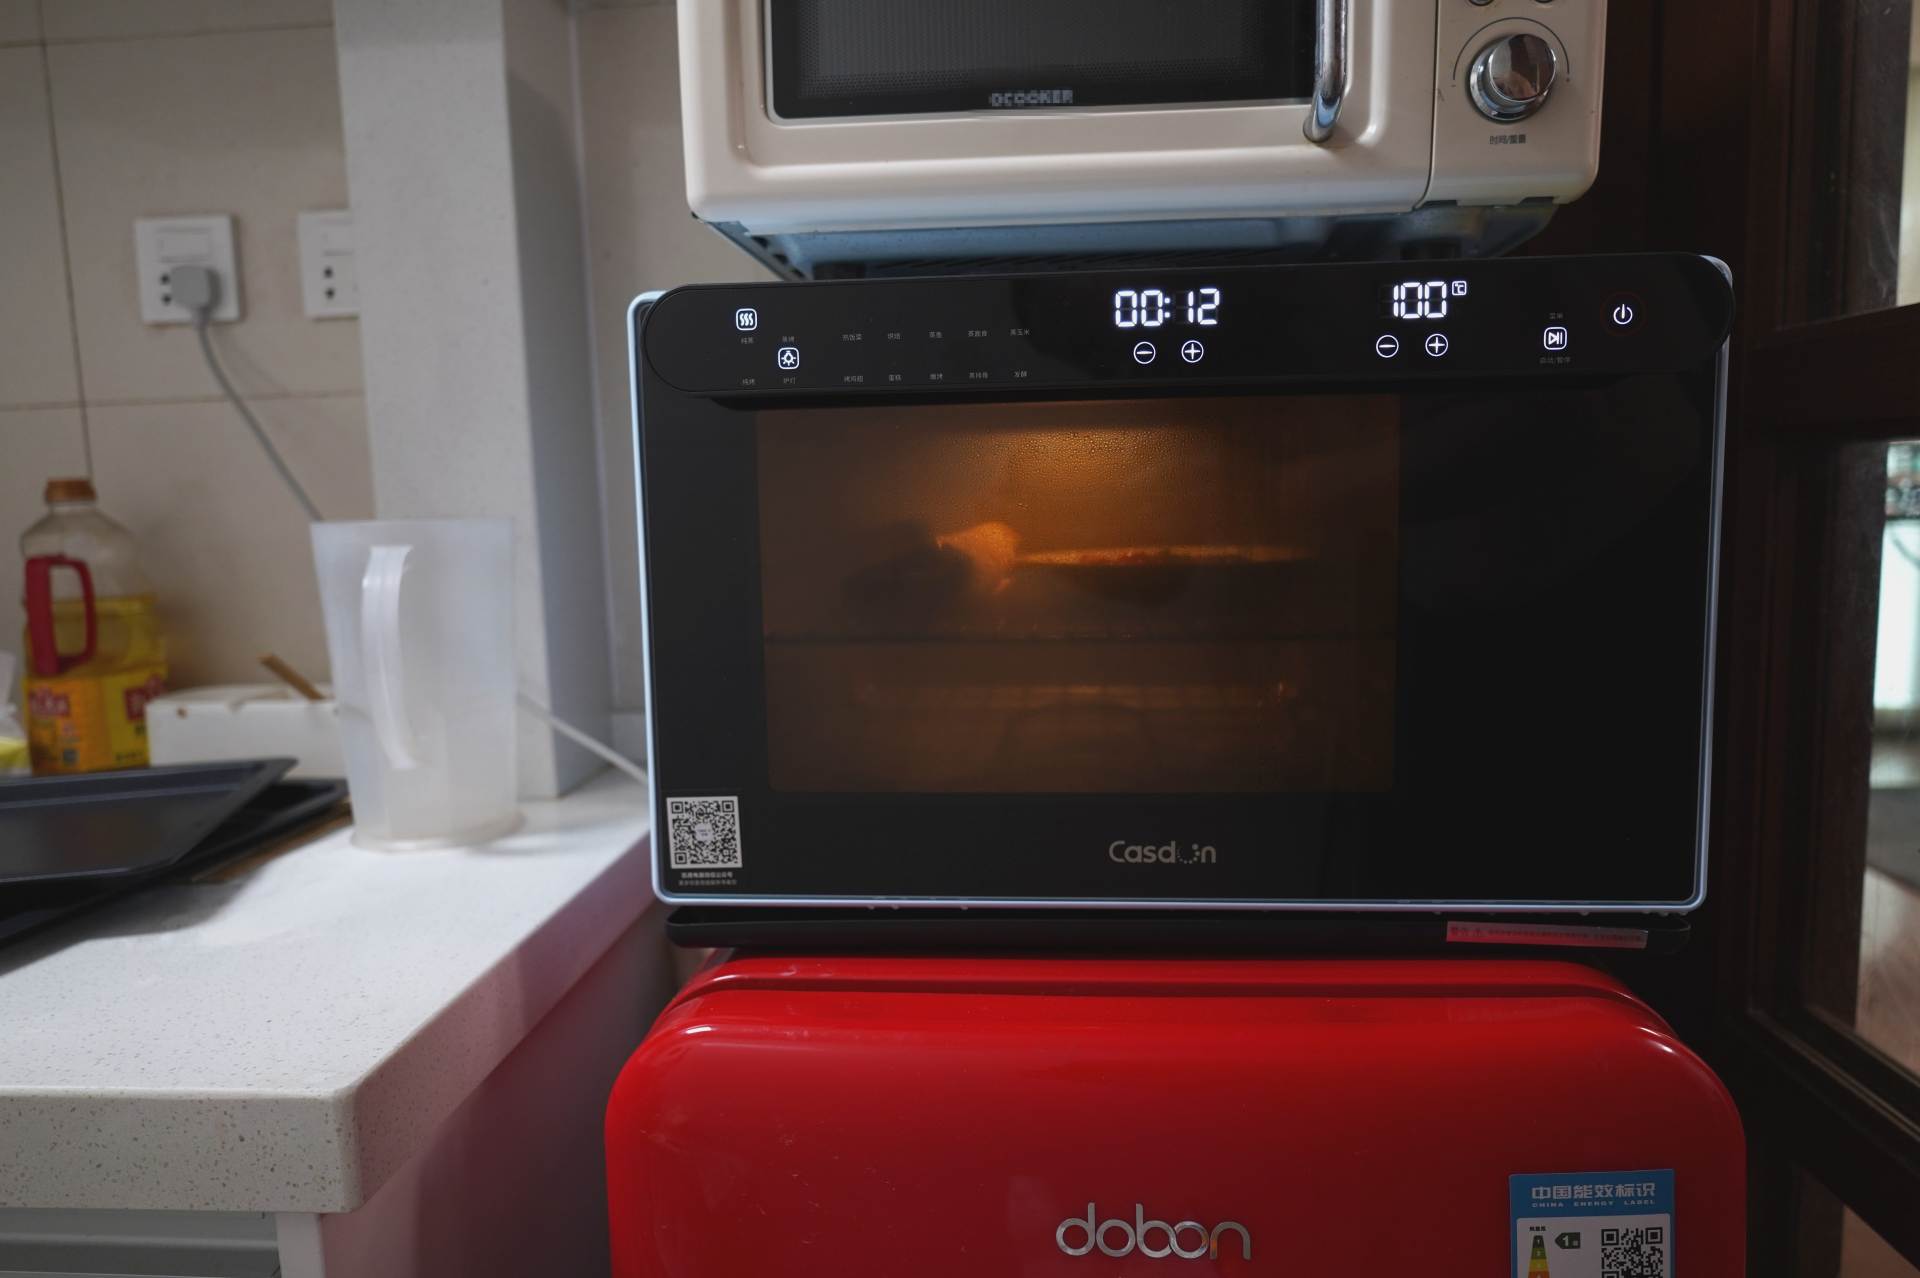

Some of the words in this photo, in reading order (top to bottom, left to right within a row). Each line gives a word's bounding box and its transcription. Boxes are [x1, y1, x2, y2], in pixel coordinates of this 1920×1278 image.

[1115, 287, 1220, 327] 00:12
[1393, 281, 1447, 319] 100
[1532, 1183, 1656, 1199] 中国能效标识
